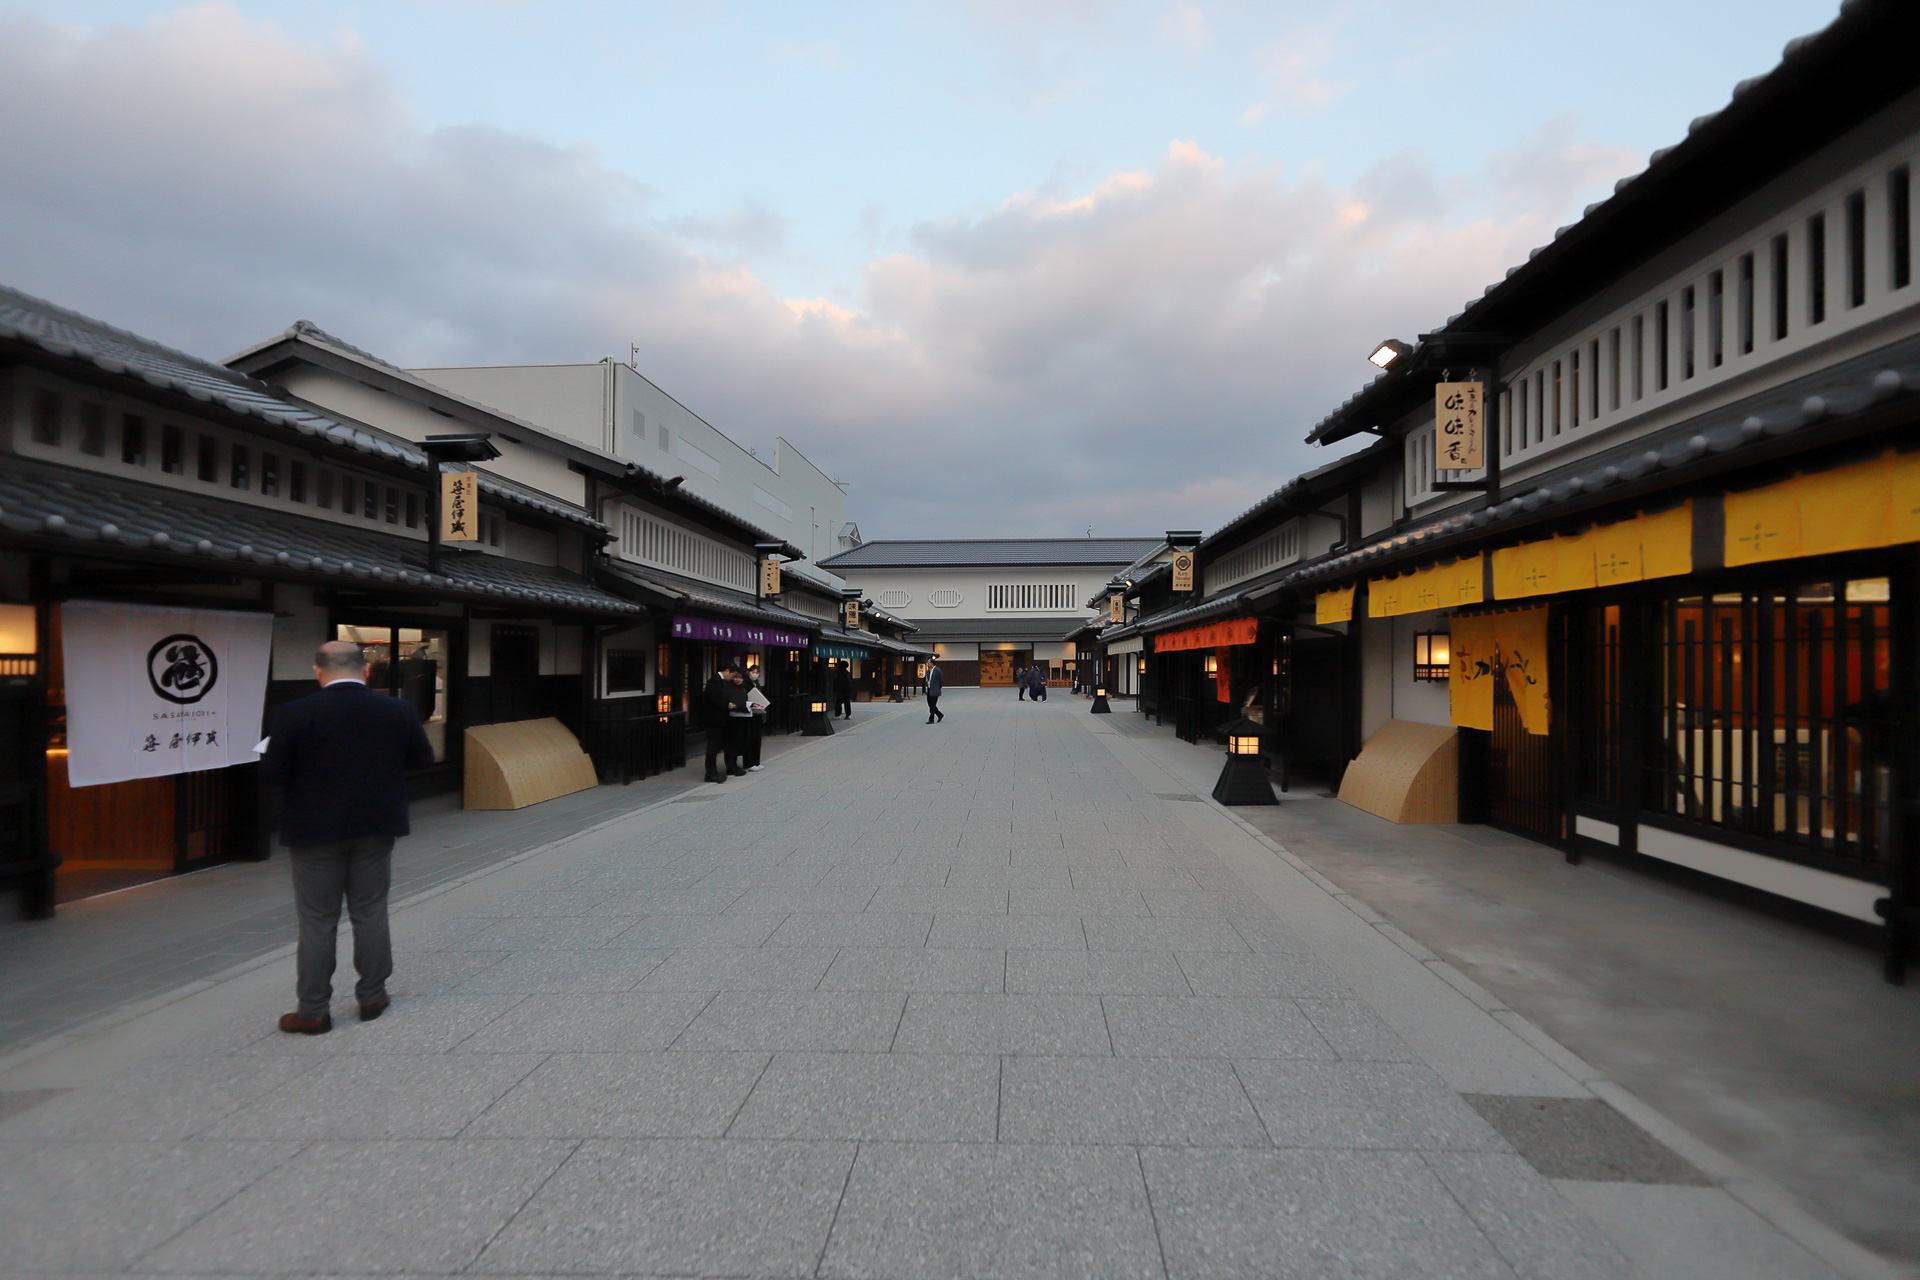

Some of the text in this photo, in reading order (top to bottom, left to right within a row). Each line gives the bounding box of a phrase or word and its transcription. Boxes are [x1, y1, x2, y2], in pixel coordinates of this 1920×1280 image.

[1443, 390, 1464, 461] 味味香
[450, 479, 467, 537] 笹屋伊織
